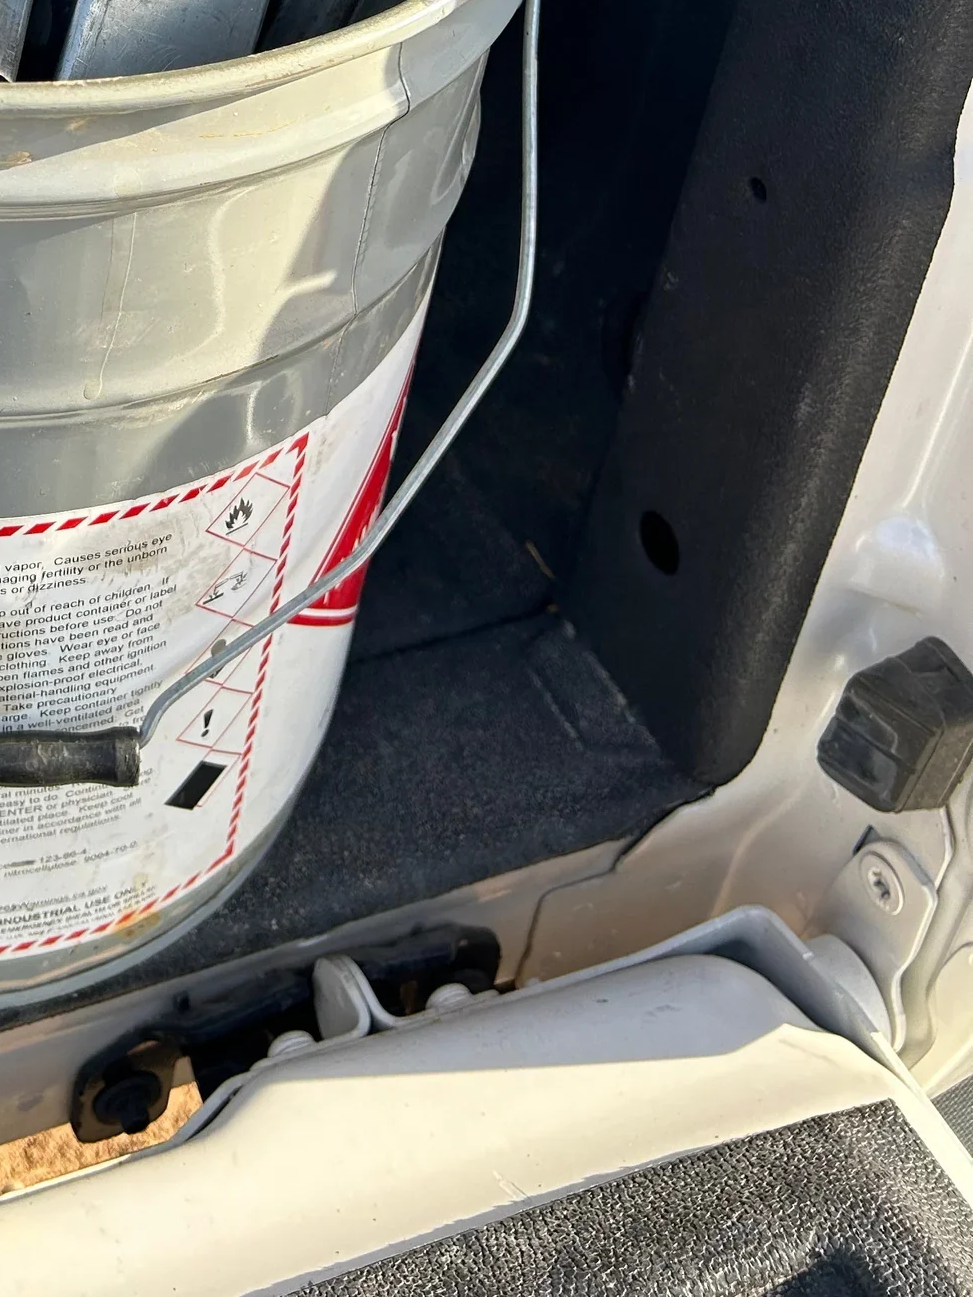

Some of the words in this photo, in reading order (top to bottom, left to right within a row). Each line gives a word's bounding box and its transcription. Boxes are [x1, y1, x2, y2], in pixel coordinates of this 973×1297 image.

[41, 565, 83, 580] fertility
[87, 562, 100, 572] or
[103, 557, 123, 569] the
[127, 545, 167, 563] unborn
[53, 551, 101, 567] Causes
[104, 540, 148, 558] serious
[151, 533, 172, 546] eye
[10, 605, 29, 617] out
[33, 603, 46, 615] of
[50, 597, 84, 612] reach
[88, 594, 101, 605] of
[161, 575, 169, 587] If
[11, 585, 24, 594] or
[25, 610, 71, 628] product
[75, 599, 132, 619] container
[134, 595, 146, 605] or
[150, 584, 177, 601] label
[34, 635, 65, 647] have
[69, 628, 98, 642] been
[102, 619, 129, 635] read
[132, 612, 153, 627] and
[49, 620, 88, 634] before
[125, 607, 142, 619] Do
[145, 599, 162, 613] not
[58, 651, 90, 665] Keep
[94, 643, 124, 658] away
[127, 634, 153, 649] from
[59, 640, 92, 654] Wear
[96, 634, 118, 647] eye
[121, 630, 133, 641] or
[136, 622, 160, 636] face
[23, 666, 64, 680] flames
[67, 659, 90, 673] and
[93, 653, 124, 668] other
[126, 640, 166, 660] ignition
[88, 657, 142, 679] electrical,
[3, 701, 33, 713] Take
[36, 685, 117, 711] precautionary
[39, 705, 71, 718] Keep
[74, 692, 126, 712] container
[130, 681, 163, 698] tightly
[2, 723, 12, 733] in
[16, 723, 23, 731] a
[28, 704, 112, 730] well-ventilated
[0, 904, 80, 926] INDUSTRIAL
[85, 896, 109, 908] USE
